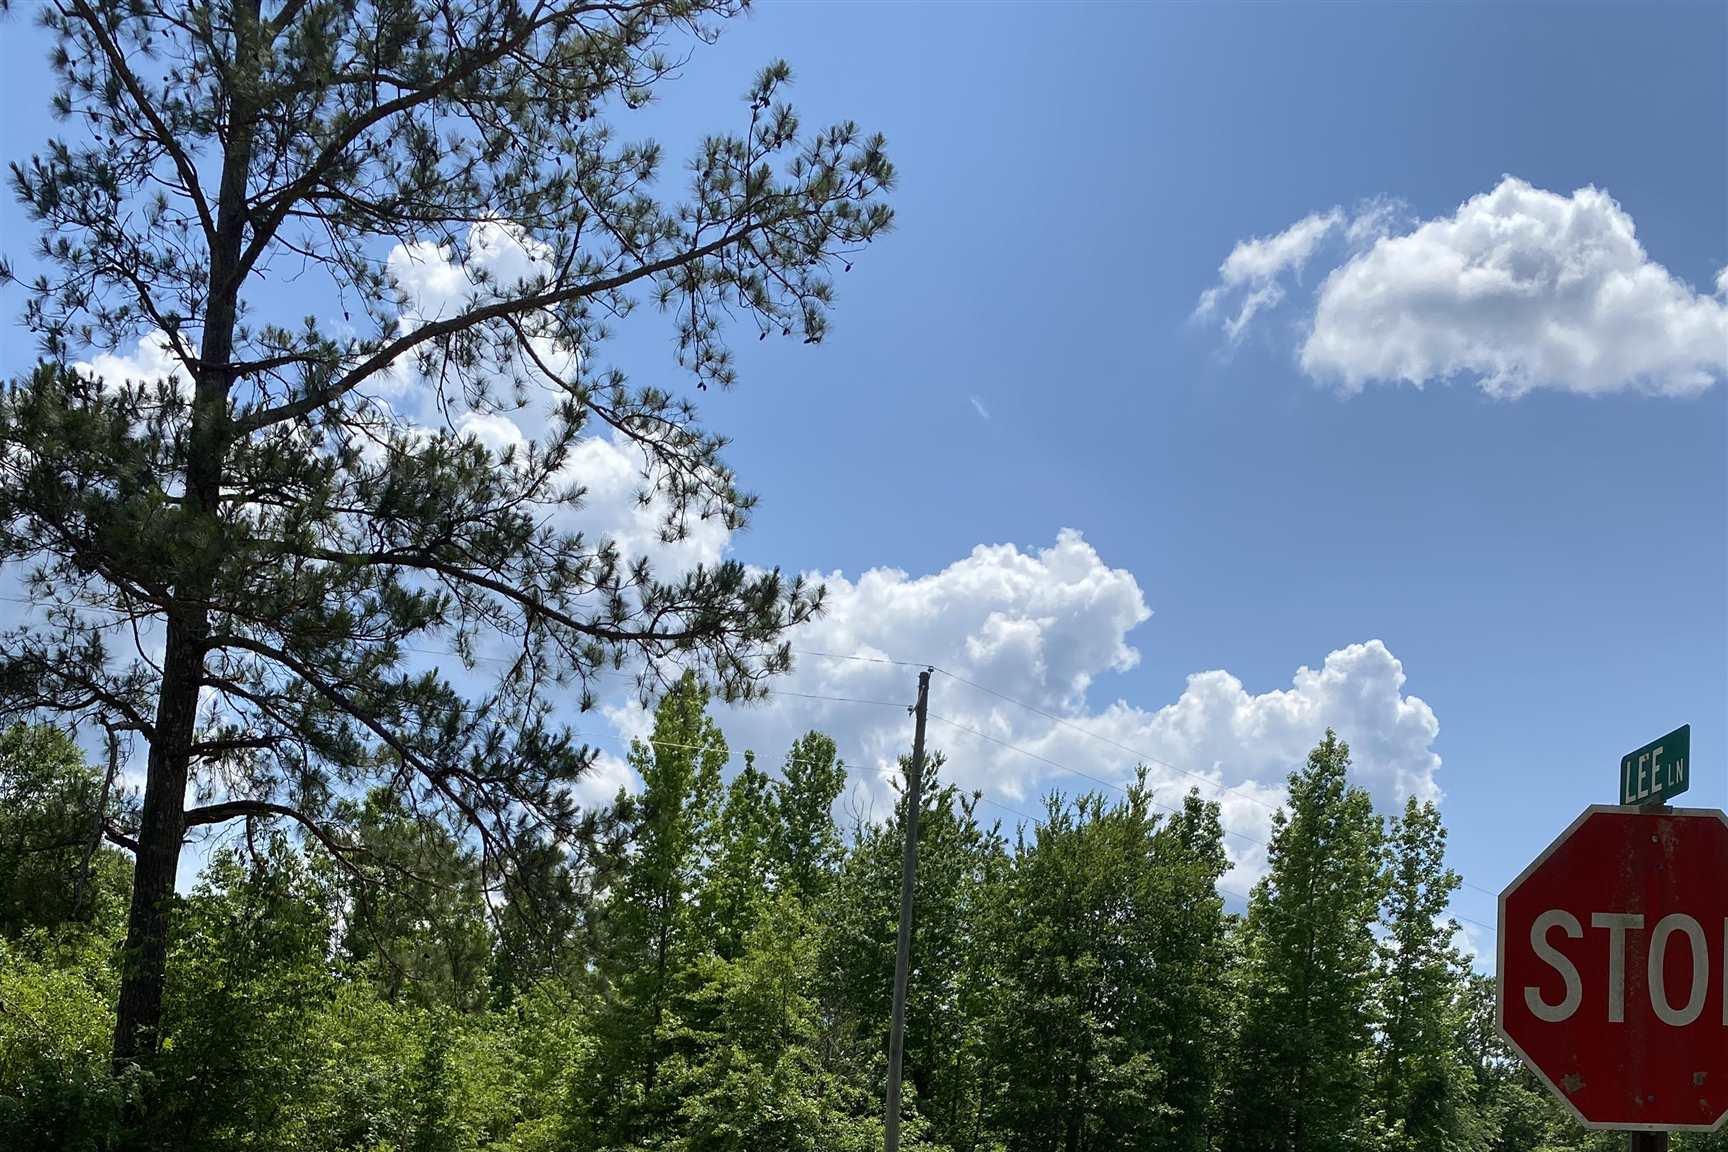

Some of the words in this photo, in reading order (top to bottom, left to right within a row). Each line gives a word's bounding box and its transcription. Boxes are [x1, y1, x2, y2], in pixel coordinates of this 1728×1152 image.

[1625, 747, 1663, 803] LEE
[1668, 758, 1684, 786] LN
[1524, 909, 1728, 1027] STO
